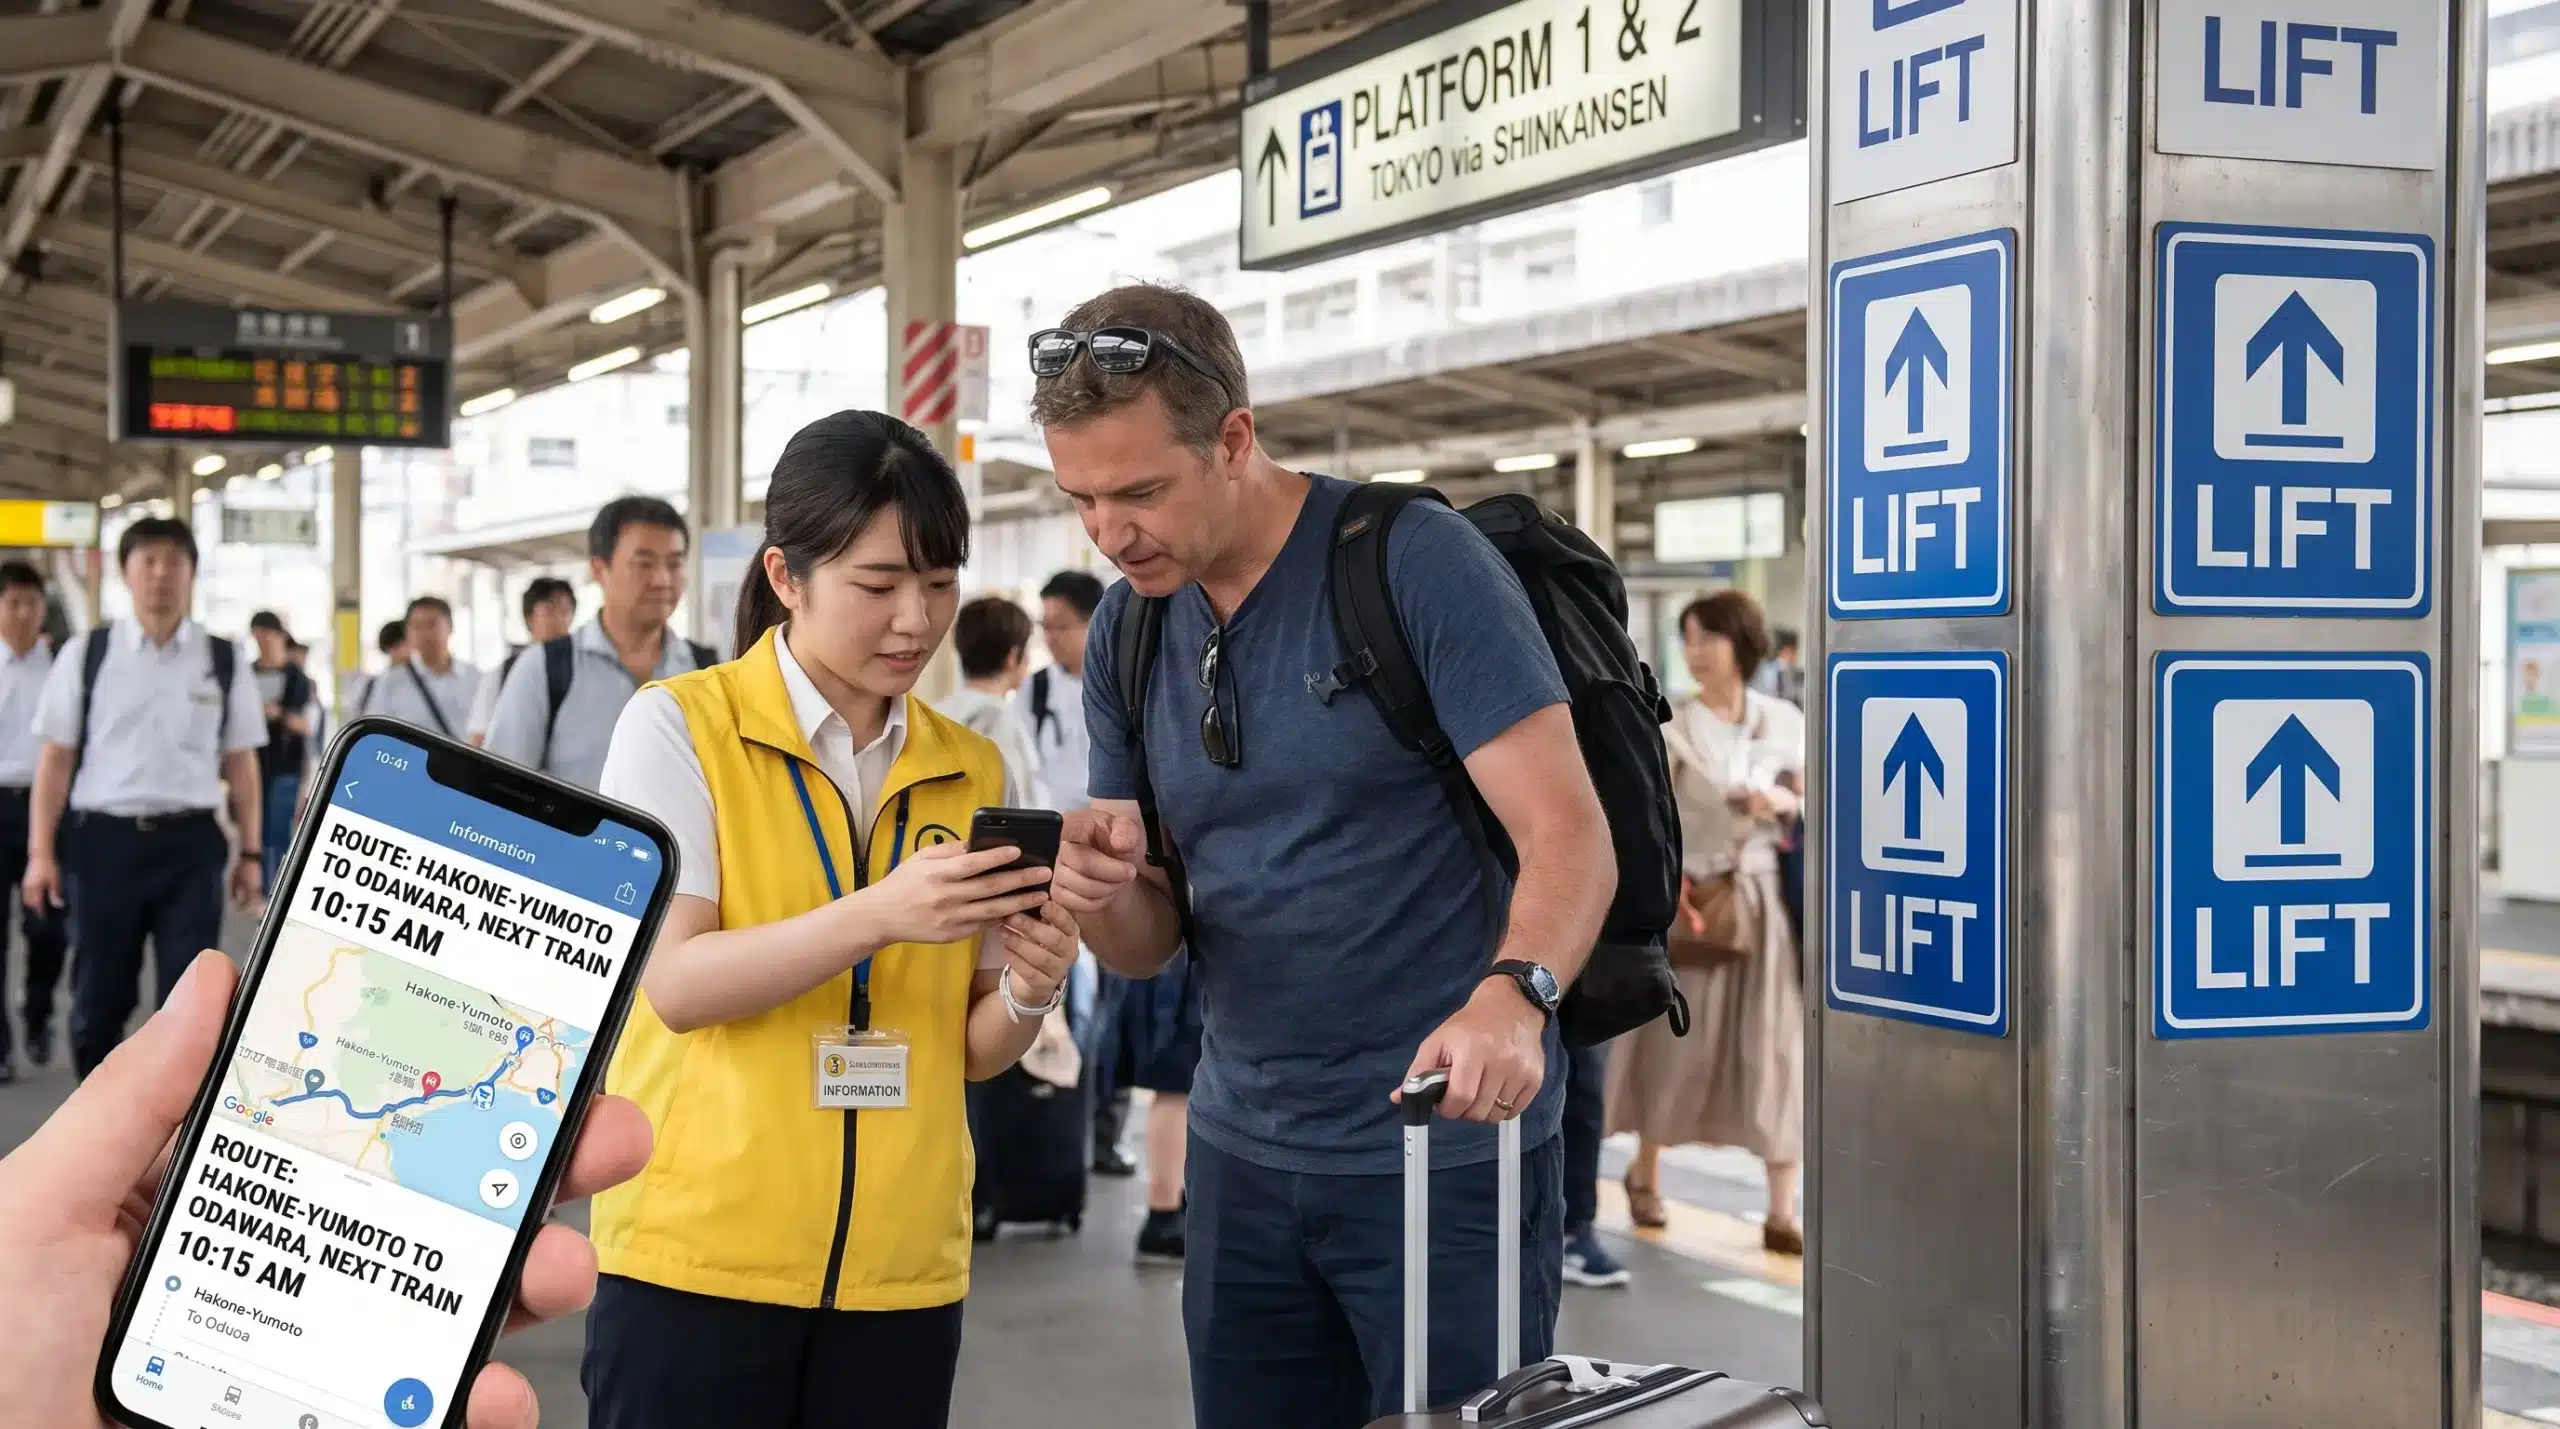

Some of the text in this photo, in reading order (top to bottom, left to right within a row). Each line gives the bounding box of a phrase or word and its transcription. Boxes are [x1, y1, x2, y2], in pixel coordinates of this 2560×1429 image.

[1353, 21, 1552, 149] PLATFORM
[1576, 6, 1590, 73] 1
[1618, 0, 1647, 60] &
[1859, 34, 1985, 149] LIFT
[2204, 15, 2398, 114] LIFT
[1371, 75, 1667, 200] TOKYO via SHINKANSEN
[1853, 487, 1981, 574] LIFT
[2197, 484, 2392, 570] LIFT
[375, 749, 409, 771] 10:41
[449, 820, 537, 865] Information
[309, 885, 445, 957] 10:15 AM
[320, 851, 612, 980] TO ODAWARA, NEXT TRAIN
[328, 823, 614, 946] ROUTE: HAKONE-YUMOTO
[1850, 890, 1977, 983] LIFT
[2196, 903, 2391, 990] LIFT
[404, 981, 514, 1032] Hakone-Yumoto
[336, 1036, 421, 1076] Hakone-Yumoto
[824, 1085, 901, 1097] INFORMATION
[224, 1095, 275, 1126] Google
[210, 1133, 299, 1183] ROUTE:
[188, 1195, 463, 1316] ODAWARA, NEXT TRAIN
[198, 1164, 444, 1273] HAKONE-YUMOTO TO
[177, 1230, 307, 1299] 10:15 AM
[186, 1309, 250, 1342] To Oduoa
[193, 1287, 303, 1337] Hakone-Yumoto
[135, 1374, 164, 1391] Home
